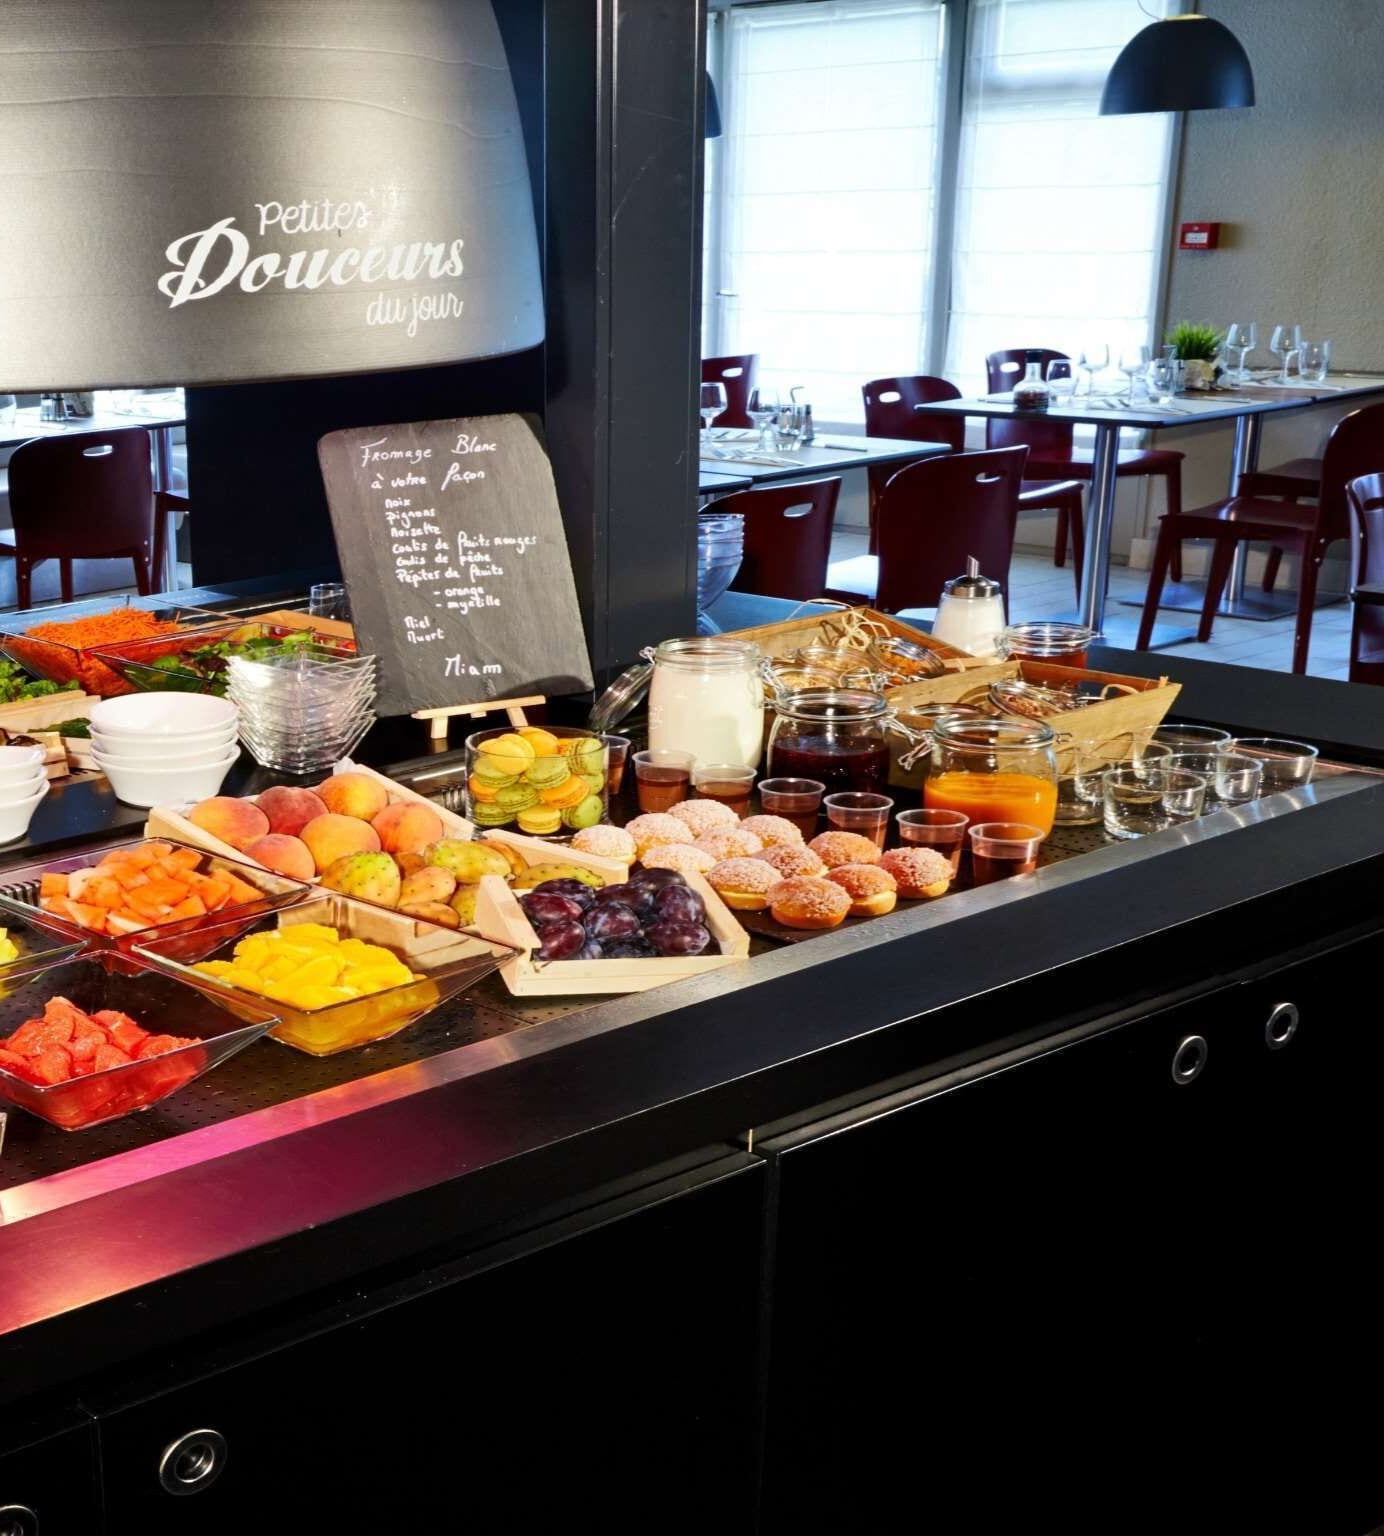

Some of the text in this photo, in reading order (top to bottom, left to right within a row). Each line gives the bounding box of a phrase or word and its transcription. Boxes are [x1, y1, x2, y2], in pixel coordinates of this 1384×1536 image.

[254, 198, 372, 236] Petites
[157, 216, 465, 309] Douceurs
[367, 291, 465, 338] du jour
[360, 434, 497, 467] Fromage Blanc
[371, 462, 486, 491] à votre façon
[434, 537, 450, 550] de
[434, 552, 449, 564] de
[444, 566, 461, 578] de
[444, 586, 485, 600] orange
